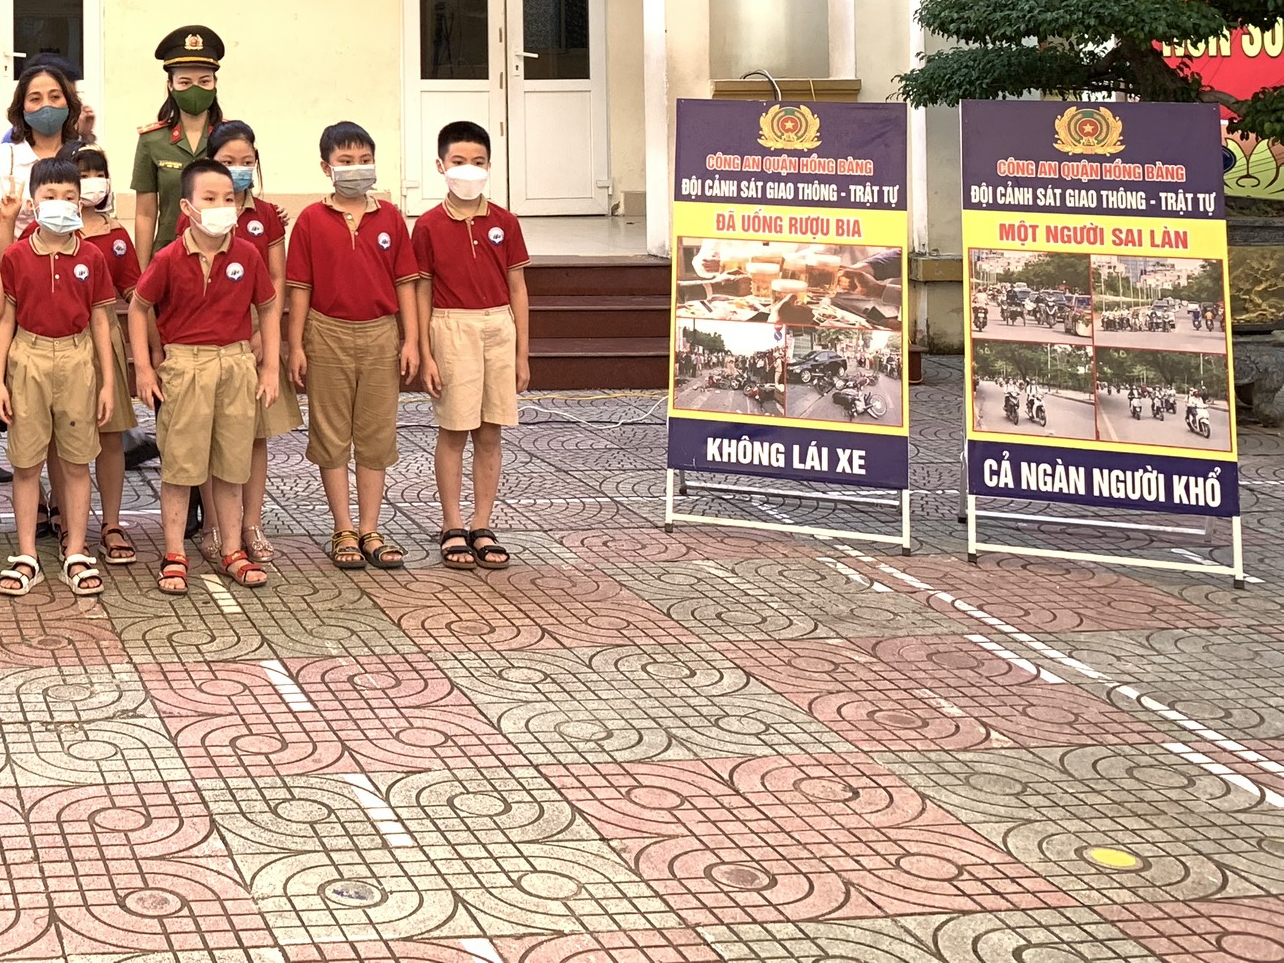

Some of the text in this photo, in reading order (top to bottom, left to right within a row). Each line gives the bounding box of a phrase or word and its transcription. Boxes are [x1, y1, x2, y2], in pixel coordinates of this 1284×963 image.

[706, 152, 740, 170] CÔNG
[742, 154, 761, 172] AN
[763, 154, 799, 176] QUẬN
[838, 157, 873, 176] BÀNG
[997, 157, 1035, 177] CÔNG
[1037, 160, 1059, 178] AN
[1060, 159, 1100, 182] QUẬN
[1145, 161, 1186, 182] BÀNG
[681, 175, 702, 199] ĐỘI
[705, 174, 737, 197] CẢNH
[741, 177, 763, 198] SÁT
[766, 182, 794, 200] GIAO
[797, 180, 837, 202] THÔNG
[849, 182, 879, 206] TRẬT
[882, 185, 899, 207] TỰ
[970, 182, 993, 207] ĐỘI
[996, 181, 1033, 205] CẢNH
[1037, 185, 1062, 206] SÁT
[1065, 189, 1097, 208] GIAO
[1101, 187, 1146, 209] THÔNG
[1159, 189, 1193, 216] TRẬT
[1197, 191, 1216, 216] TỰ
[716, 208, 862, 240] ĐÃ UỐNG RƯỢU BIA
[999, 220, 1188, 249] MỘT NGƯỜI SAI LÀN
[706, 434, 866, 475] KHÔNG LÁI XE
[983, 450, 1222, 508] CẢ NGÀN NGƯỜI KHỔ
